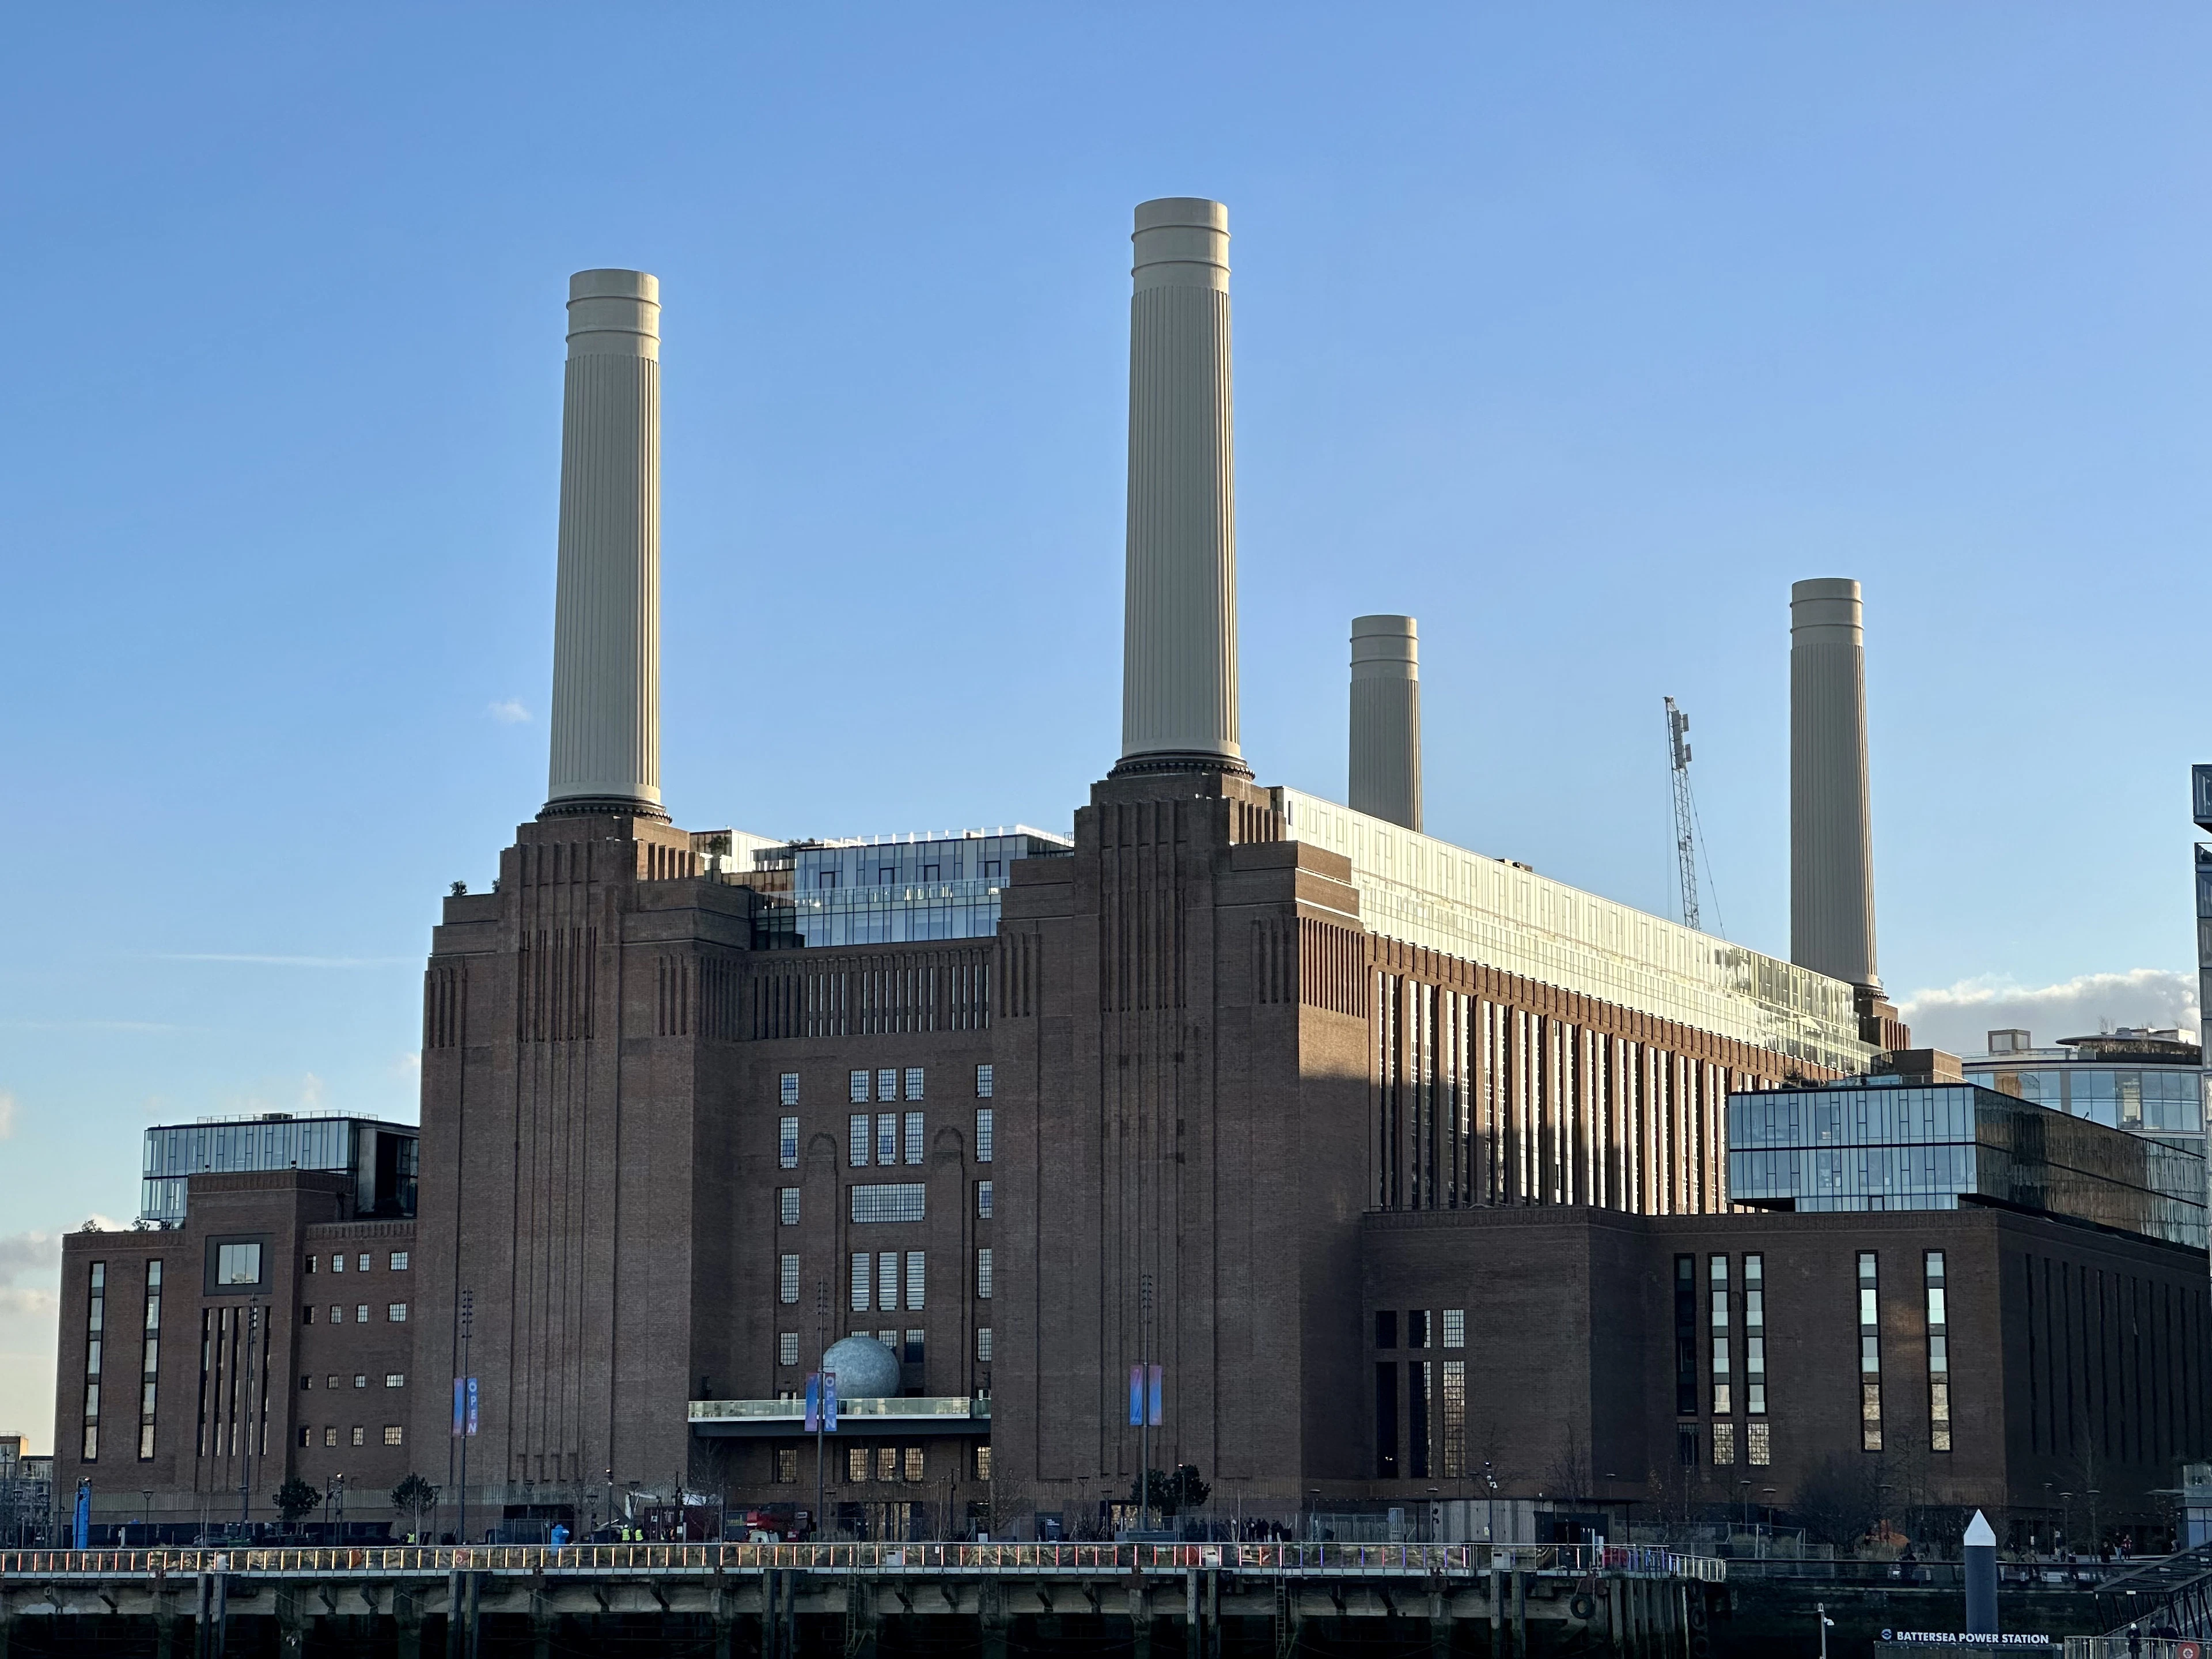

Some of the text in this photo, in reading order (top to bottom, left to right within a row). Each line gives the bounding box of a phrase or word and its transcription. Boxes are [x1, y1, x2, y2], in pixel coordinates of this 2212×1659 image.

[468, 1381, 477, 1433] OPEN
[825, 1376, 835, 1429] OPEN
[1897, 1631, 2049, 1643] BATTERSEA POWER STATION
